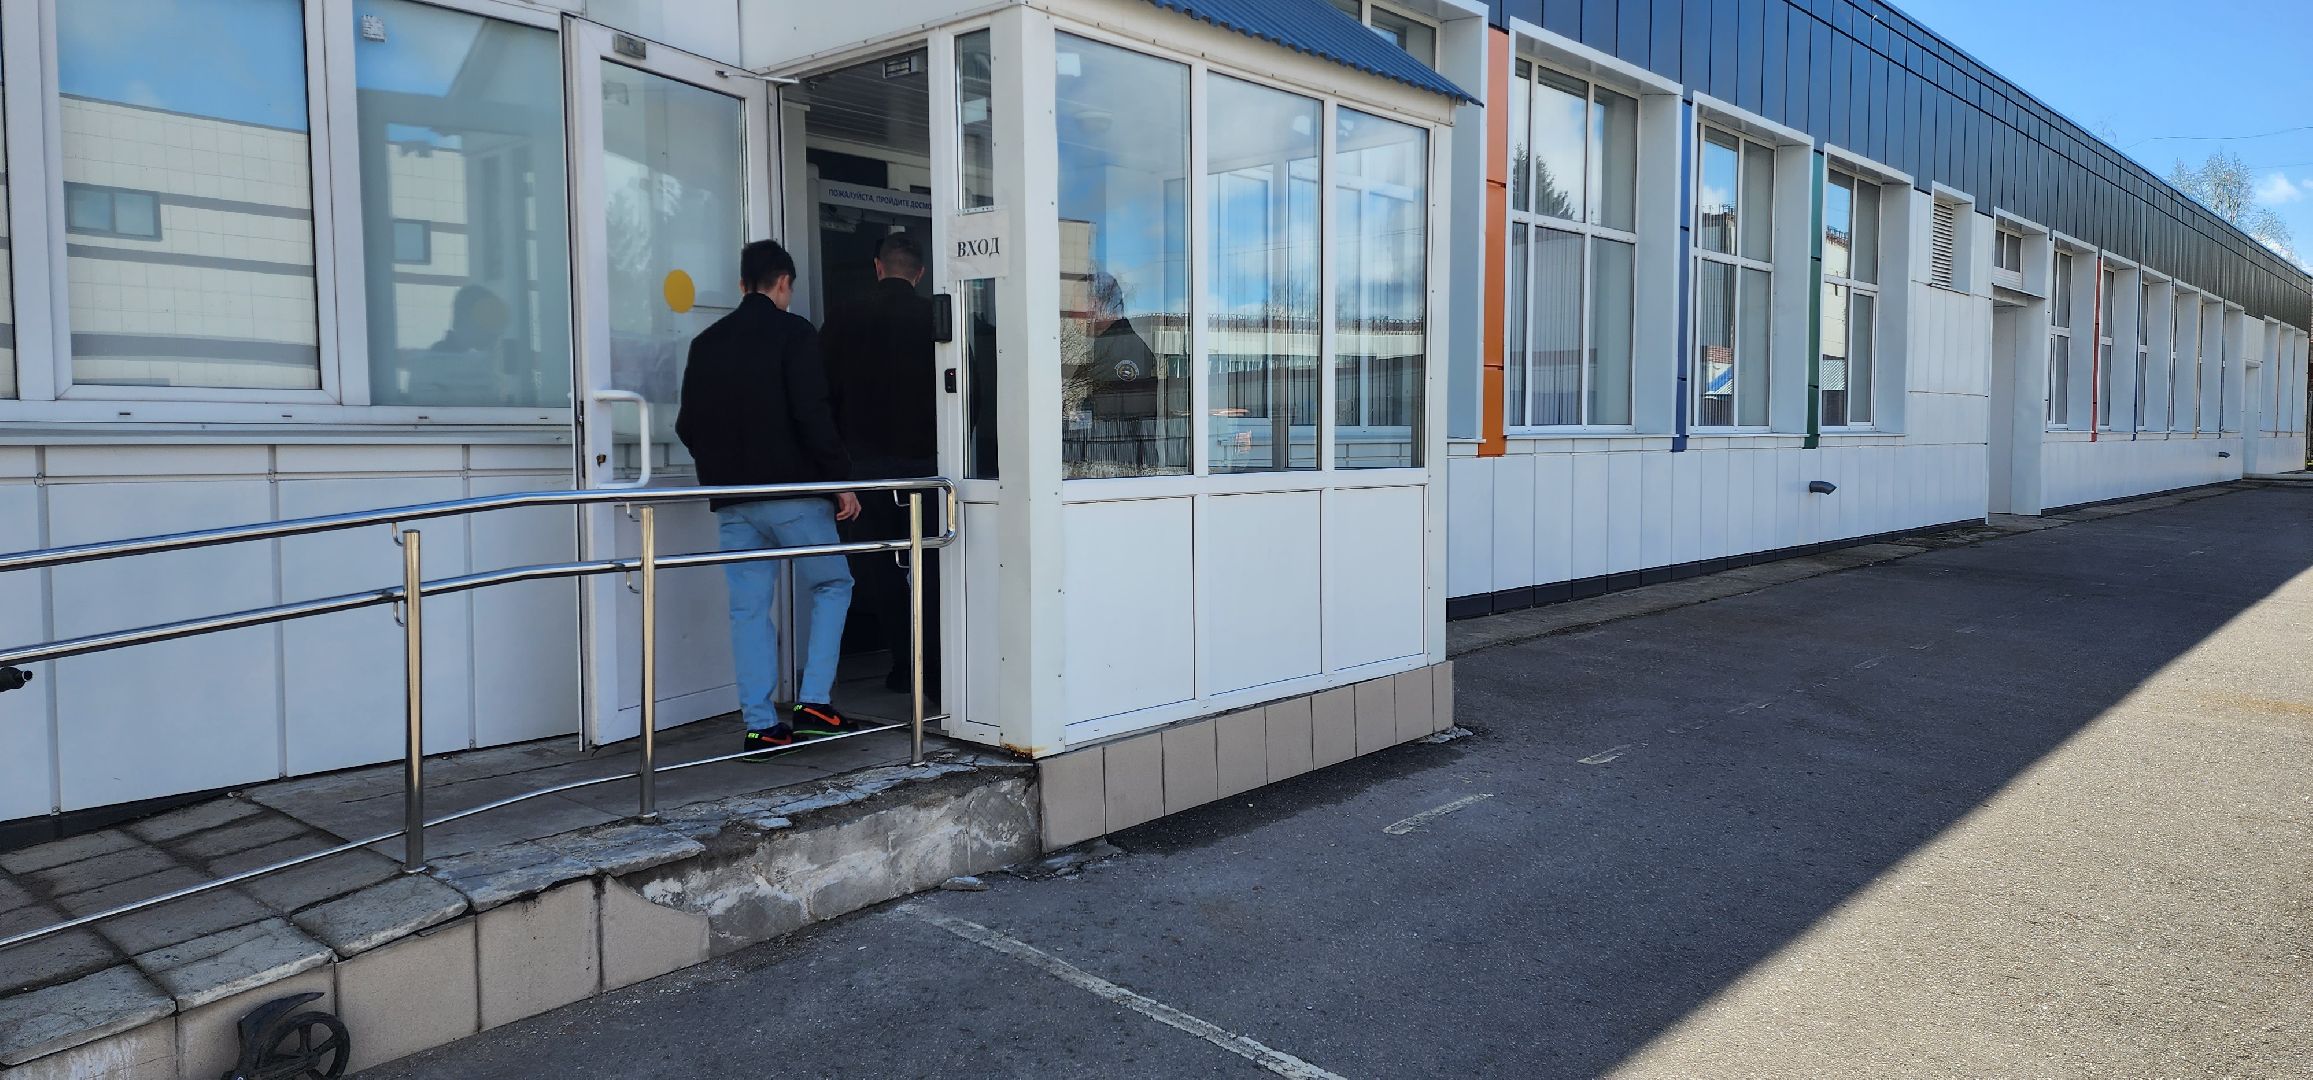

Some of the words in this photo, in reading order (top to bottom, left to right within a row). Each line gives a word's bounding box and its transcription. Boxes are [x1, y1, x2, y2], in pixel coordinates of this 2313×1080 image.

[829, 188, 874, 203] ПОЖАЛУЙСТА,
[876, 195, 909, 207] ПРОЙДИТЕ
[957, 237, 1000, 257] ВХОД
